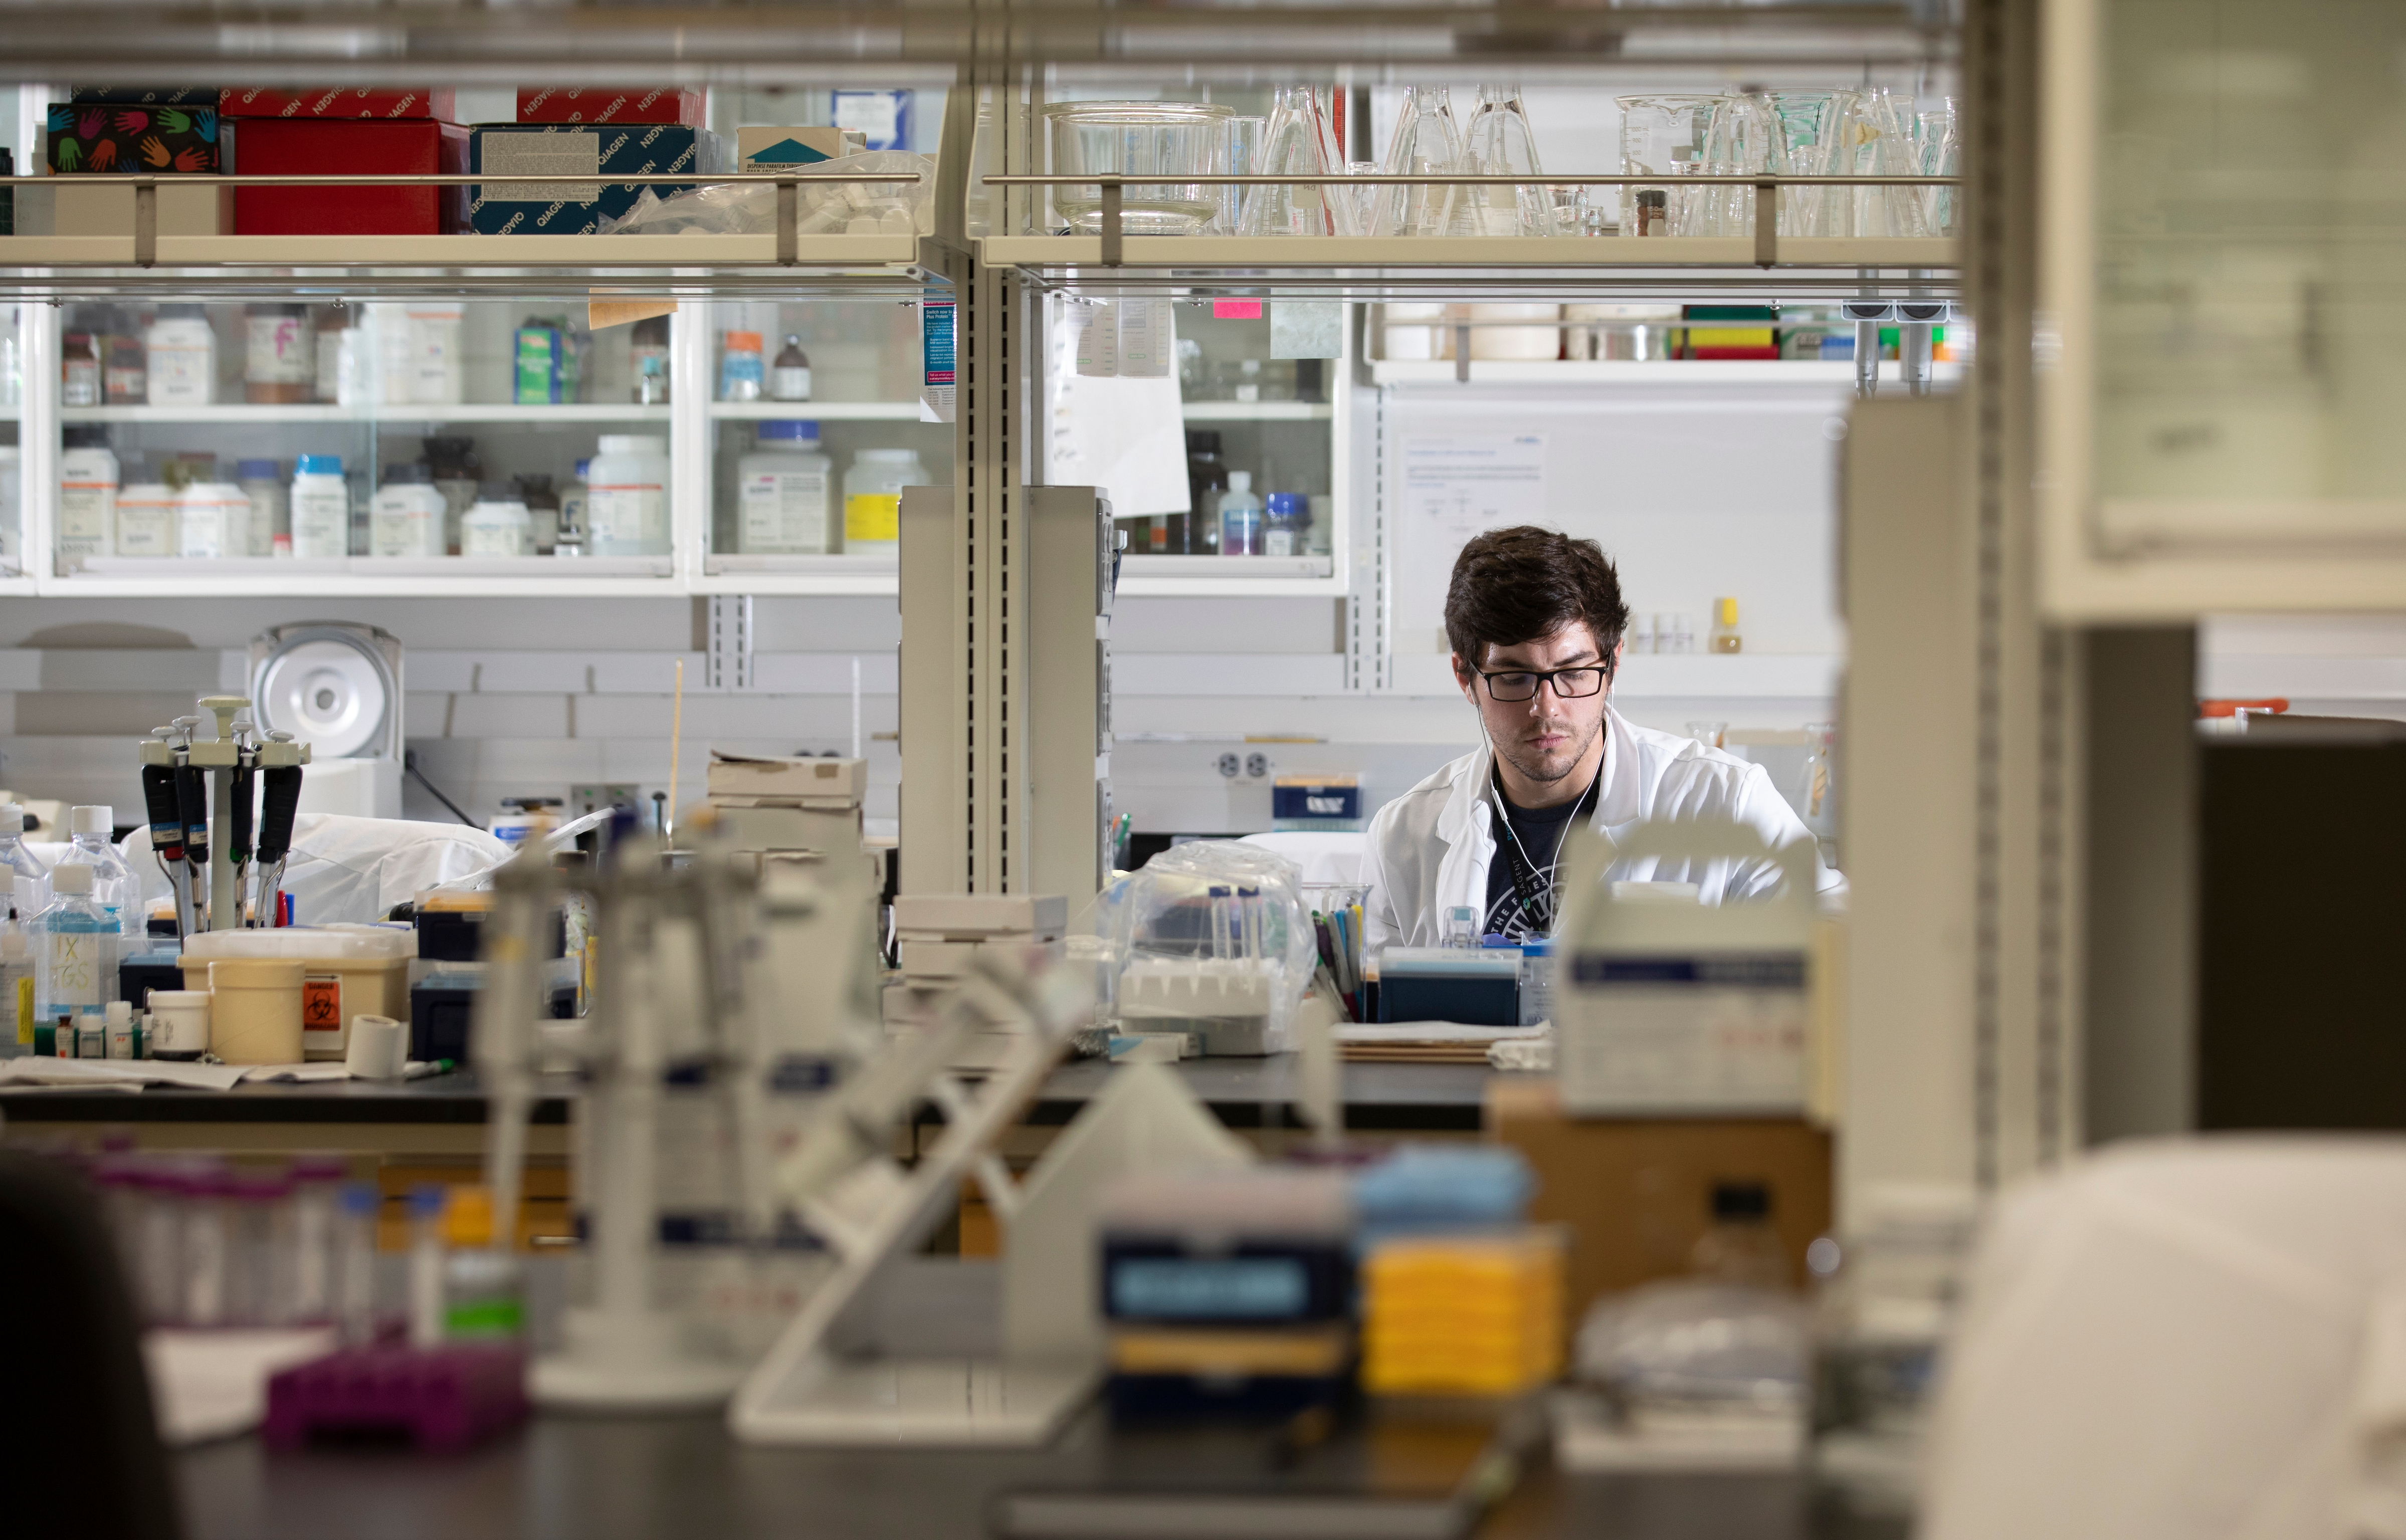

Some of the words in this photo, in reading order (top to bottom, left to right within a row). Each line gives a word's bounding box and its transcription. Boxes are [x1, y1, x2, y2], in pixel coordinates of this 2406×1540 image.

[598, 132, 630, 165] QIAGEN
[1513, 859, 1527, 895] SAGENT
[1491, 908, 1510, 933] THE
